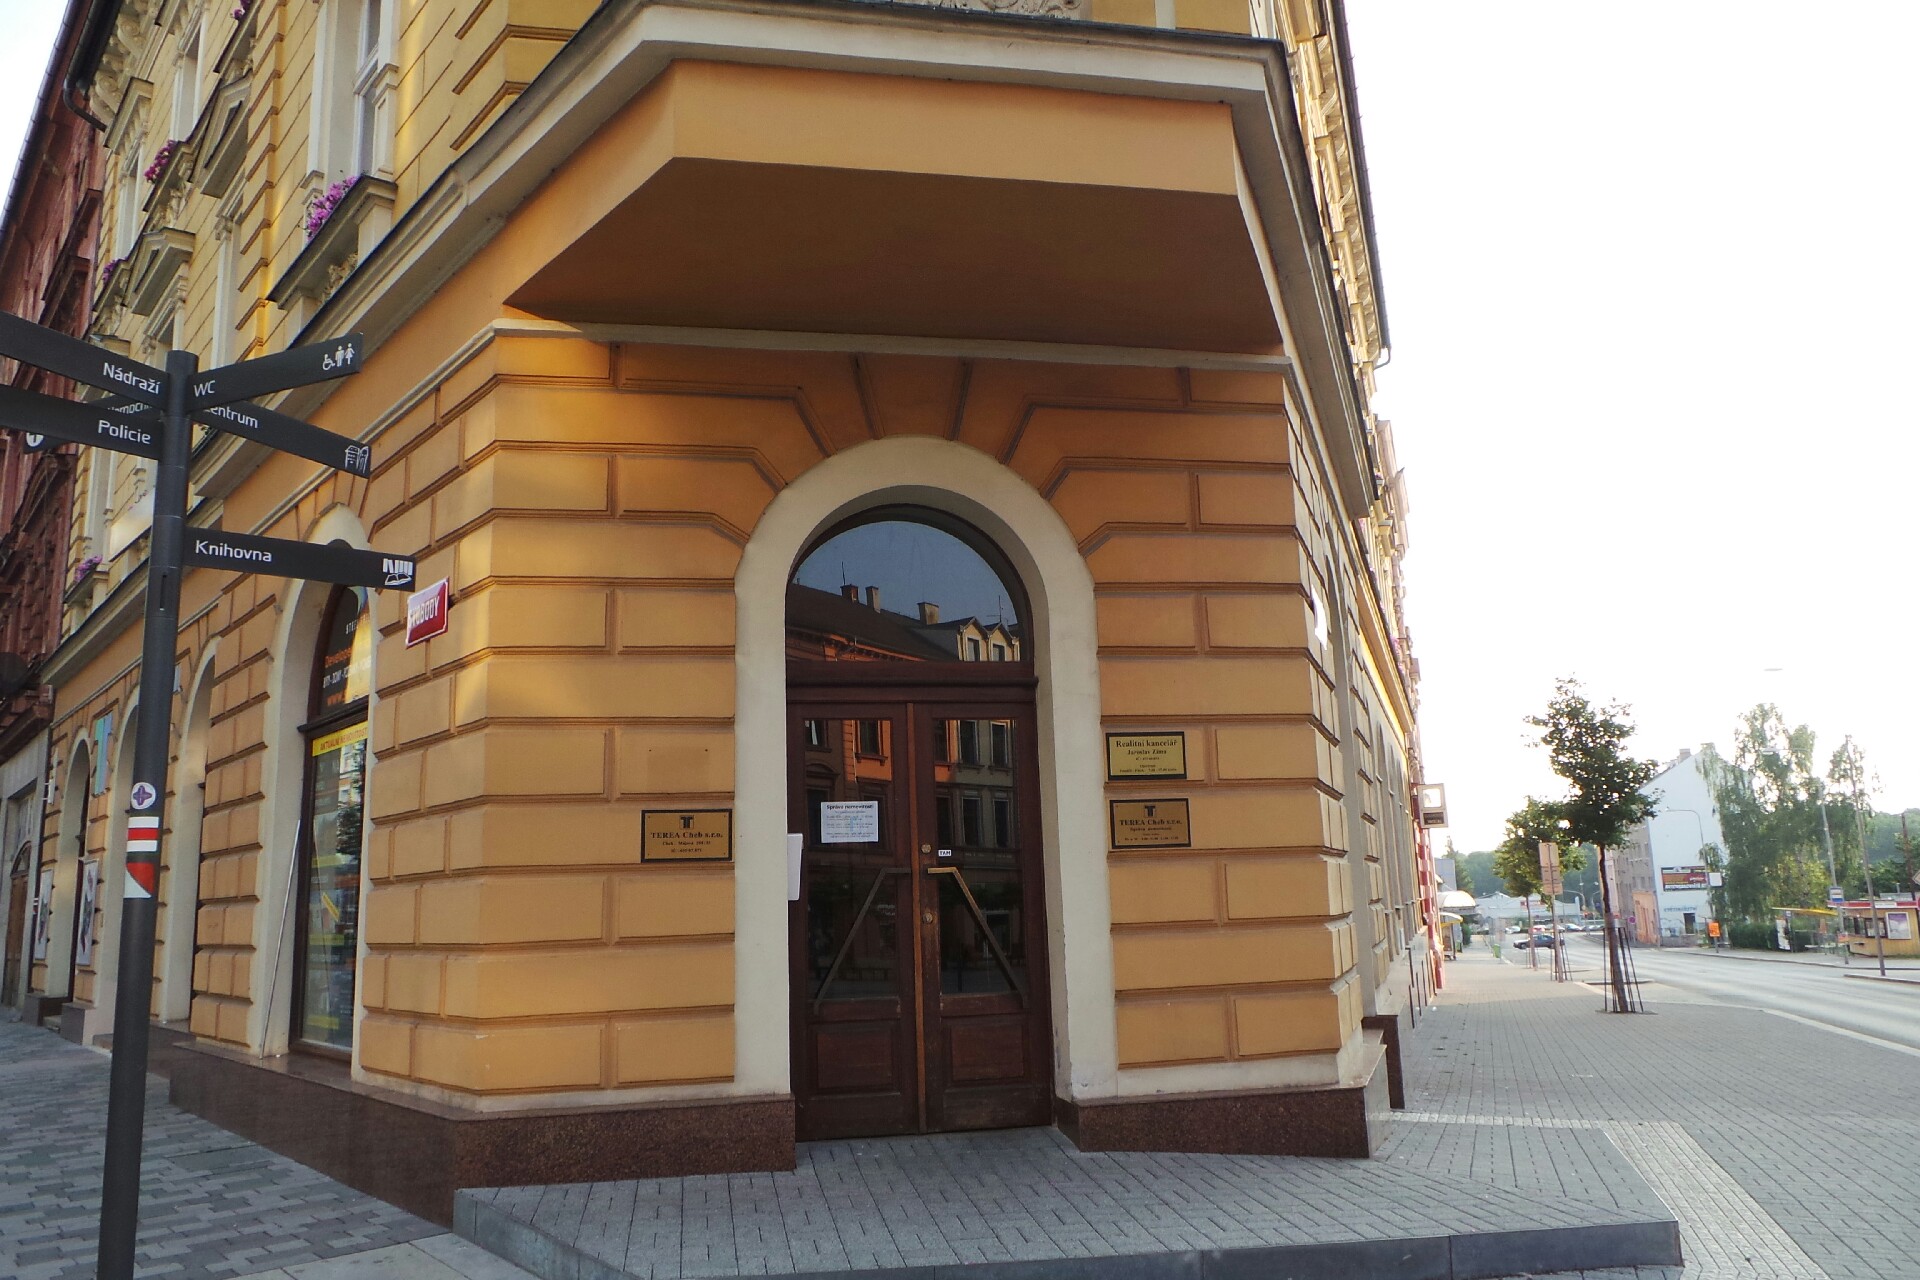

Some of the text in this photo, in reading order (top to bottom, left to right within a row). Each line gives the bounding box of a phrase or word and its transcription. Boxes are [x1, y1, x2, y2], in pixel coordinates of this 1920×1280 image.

[103, 362, 161, 394] Nádraží
[194, 380, 216, 397] WC
[98, 419, 151, 444] Policie
[195, 540, 272, 562] Knihovna
[682, 831, 703, 839] Cheb
